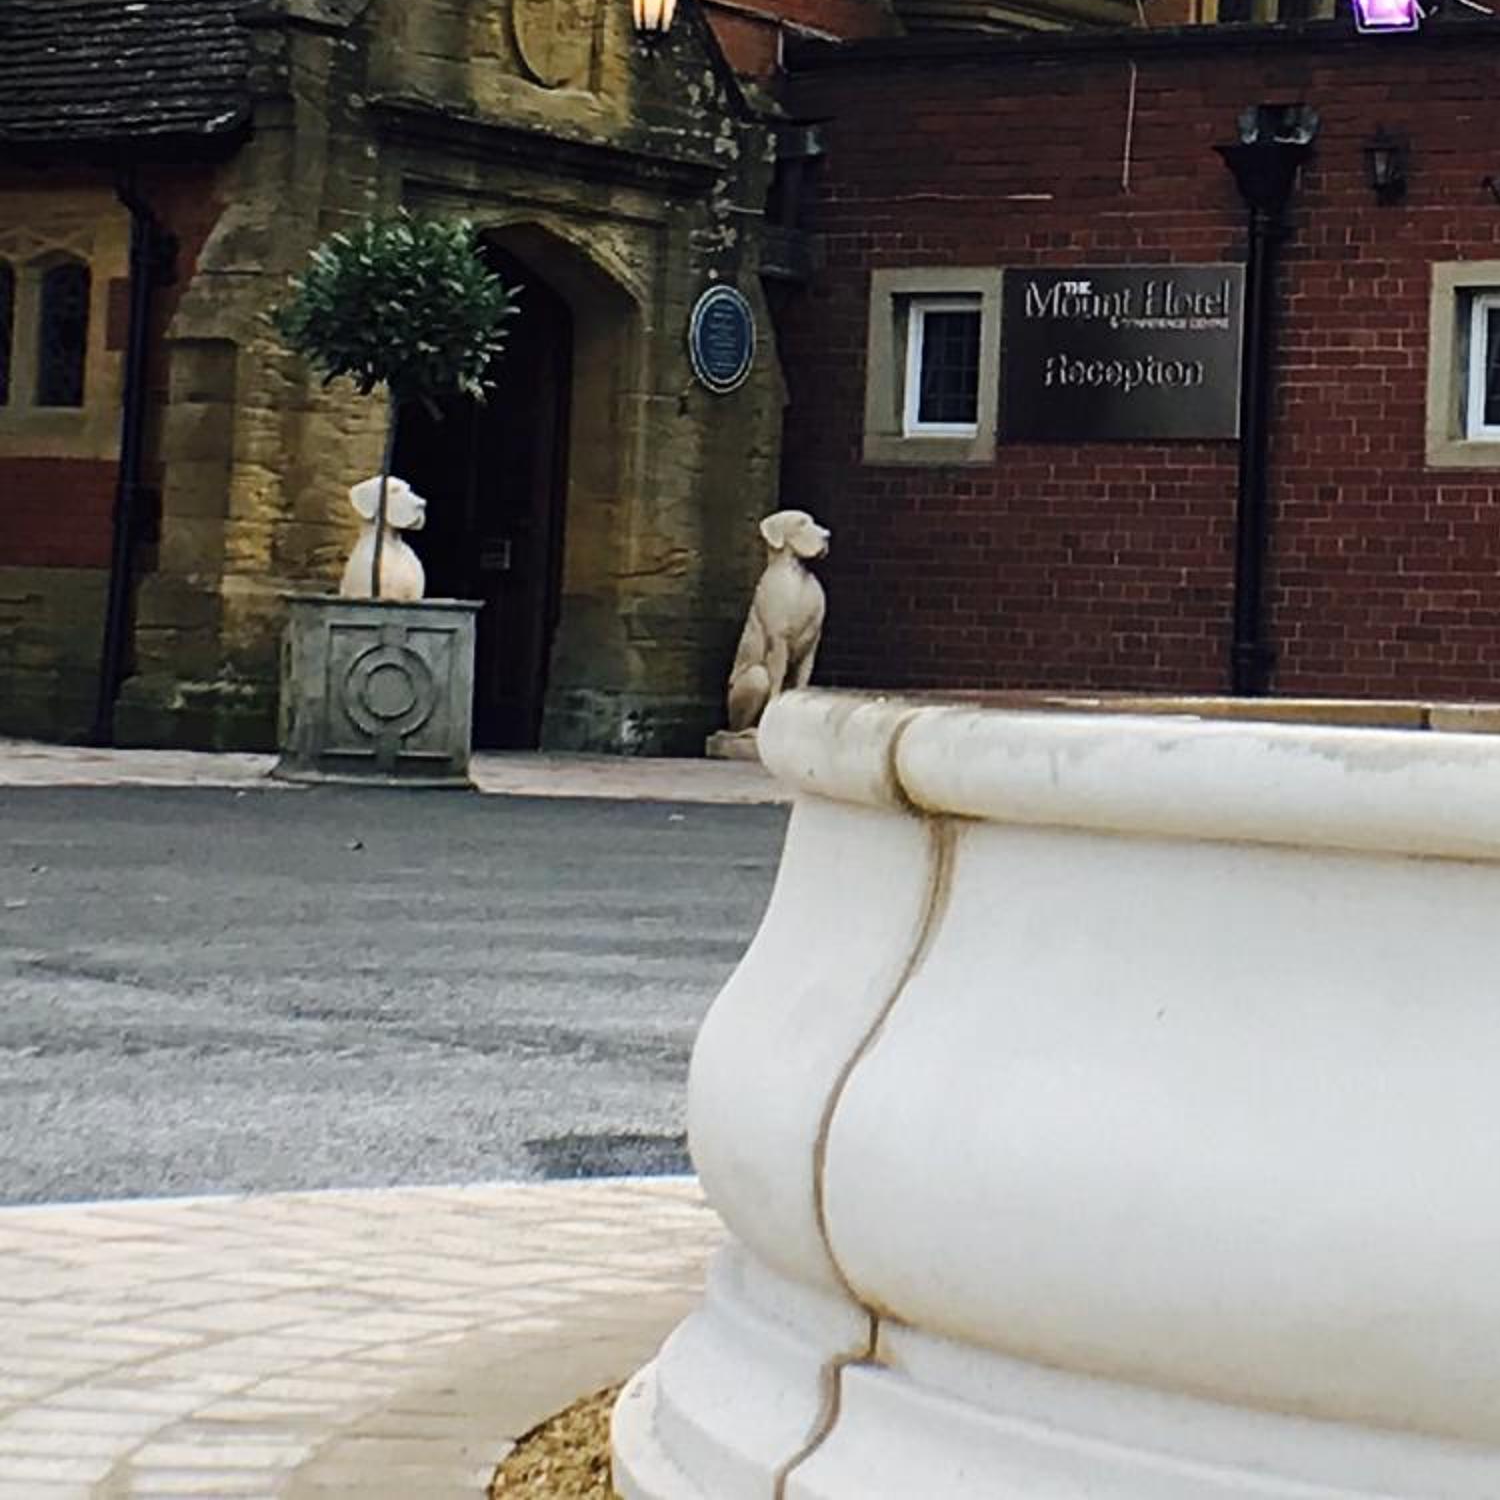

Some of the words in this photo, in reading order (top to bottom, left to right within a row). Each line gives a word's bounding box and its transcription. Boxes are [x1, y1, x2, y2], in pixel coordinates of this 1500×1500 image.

[1025, 280, 1131, 318] Mount
[1145, 278, 1229, 316] Hotel
[1044, 354, 1205, 392] Reception
